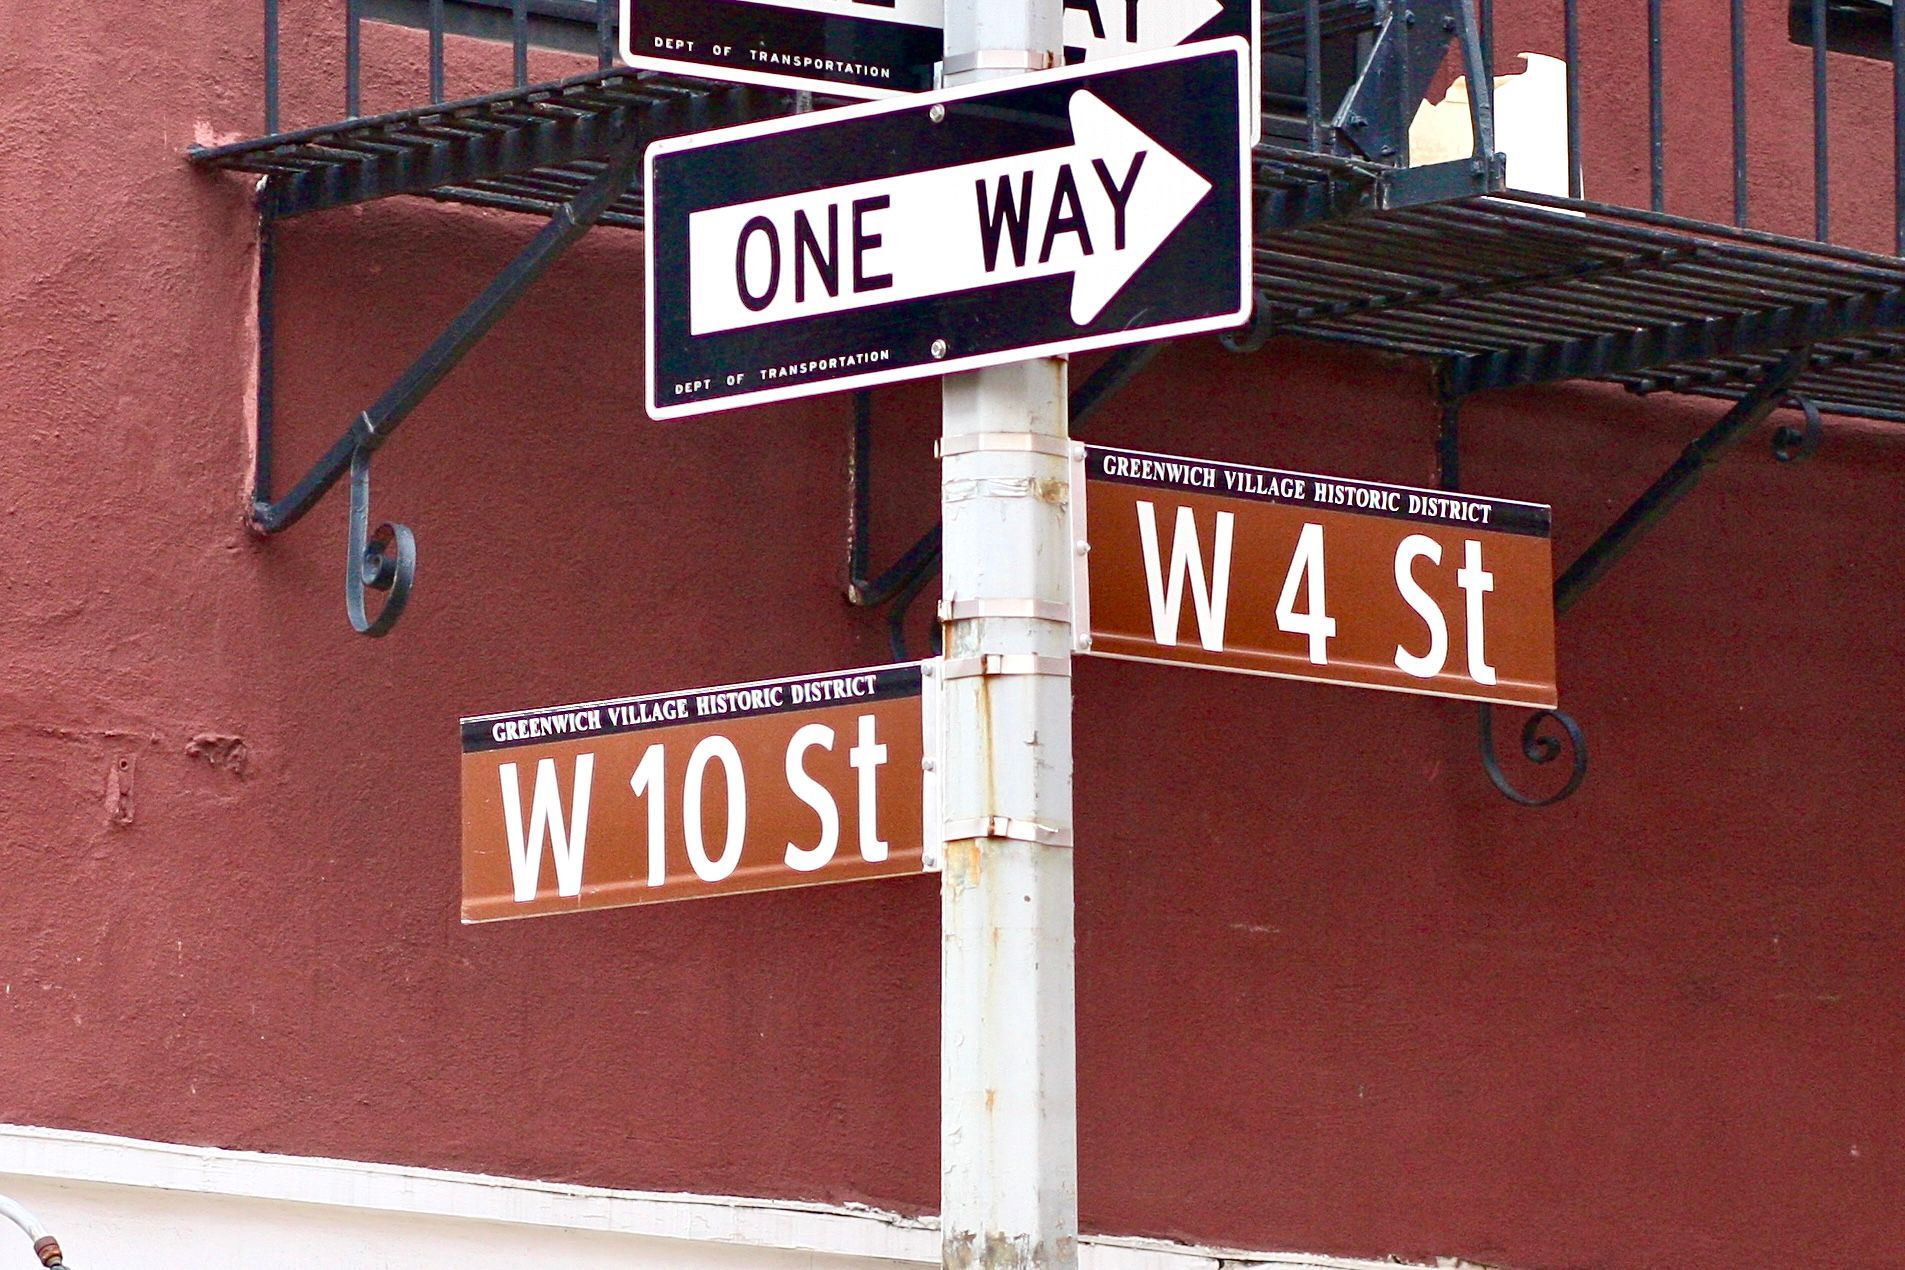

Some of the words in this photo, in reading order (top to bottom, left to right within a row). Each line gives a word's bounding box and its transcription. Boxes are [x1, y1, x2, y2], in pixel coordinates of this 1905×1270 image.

[655, 37, 694, 52] DEPT
[712, 45, 732, 56] OF
[750, 50, 890, 78] TRANSPORTATION
[736, 194, 893, 311] ONE
[975, 150, 1148, 273] WAY
[675, 379, 711, 394] DEPT
[726, 373, 744, 386] OF
[760, 350, 889, 379] TRANSPORTATION
[1103, 454, 1216, 488] GREENWICH
[1223, 470, 1306, 499] VILLAGE
[1314, 483, 1400, 511] HISTORIC
[1408, 495, 1492, 523] DISTRICT
[1136, 501, 1234, 652] W
[1274, 523, 1337, 664] 4
[1394, 534, 1496, 685] St
[492, 709, 601, 742] GREENWICH
[608, 698, 688, 726] VILLAGE
[696, 686, 783, 716] HISTORIC
[791, 675, 876, 705] DISTRICT
[498, 753, 595, 902] W
[630, 735, 747, 887] 10
[784, 714, 889, 871] St
